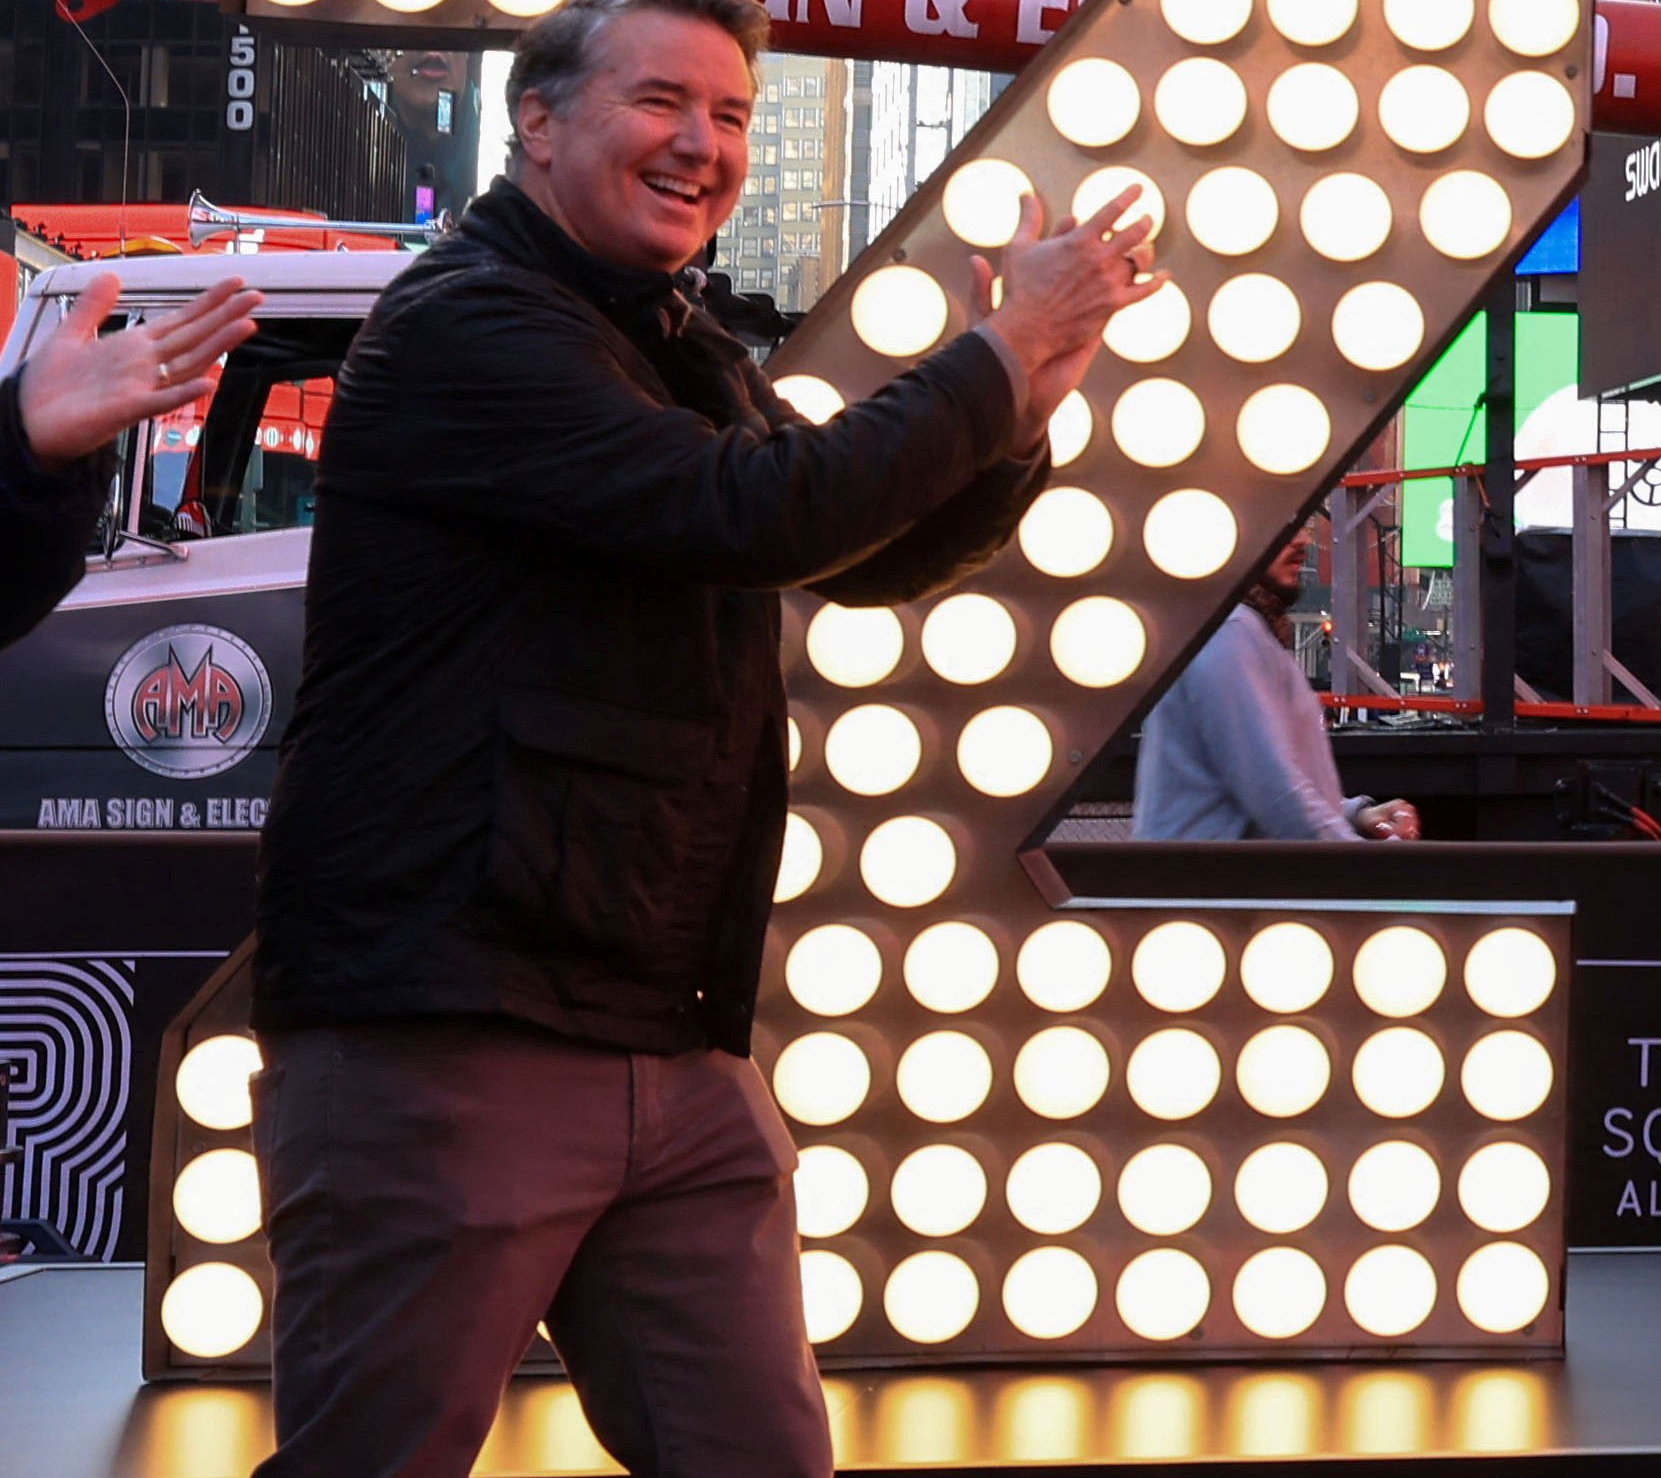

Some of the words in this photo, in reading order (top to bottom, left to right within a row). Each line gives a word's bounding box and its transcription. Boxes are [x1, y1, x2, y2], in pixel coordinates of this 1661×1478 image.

[130, 641, 246, 746] AMA
[37, 797, 102, 829] AMA
[106, 797, 174, 829] SIGN
[180, 803, 201, 829] &
[206, 796, 272, 829] ELEC
